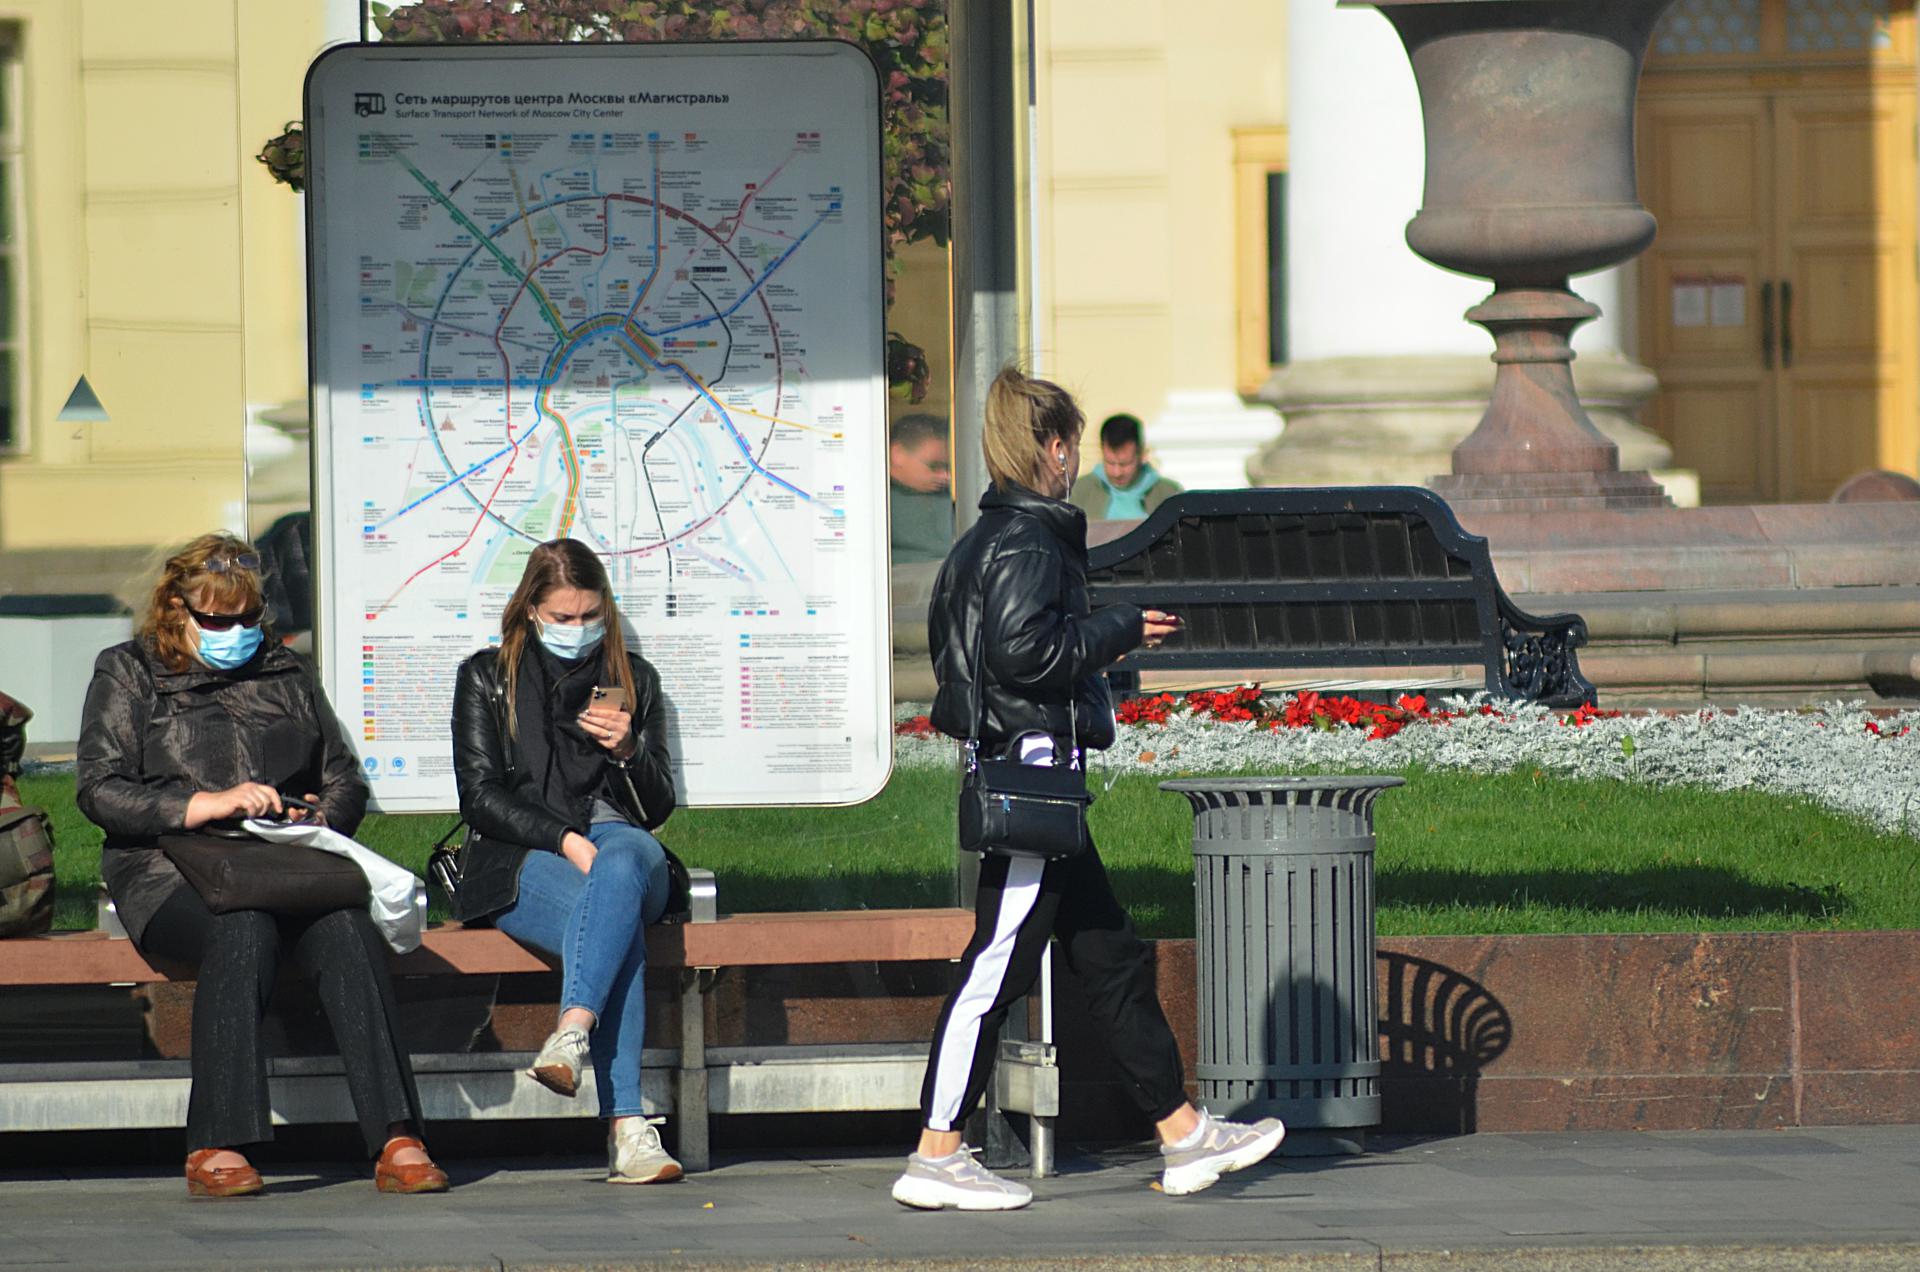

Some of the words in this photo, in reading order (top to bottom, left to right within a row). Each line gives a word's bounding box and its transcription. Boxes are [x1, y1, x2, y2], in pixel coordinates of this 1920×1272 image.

[395, 92, 427, 105] Сеть
[431, 94, 511, 108] маршрутов
[515, 94, 564, 107] центра
[567, 92, 625, 105] Москвы
[629, 92, 730, 106] «Магистраль»
[395, 109, 430, 118] Surface
[433, 109, 476, 120] Transport
[479, 109, 517, 118] Network
[520, 109, 529, 118] of
[532, 109, 570, 118] Moscow
[573, 109, 591, 119] City
[593, 109, 624, 118] Center
